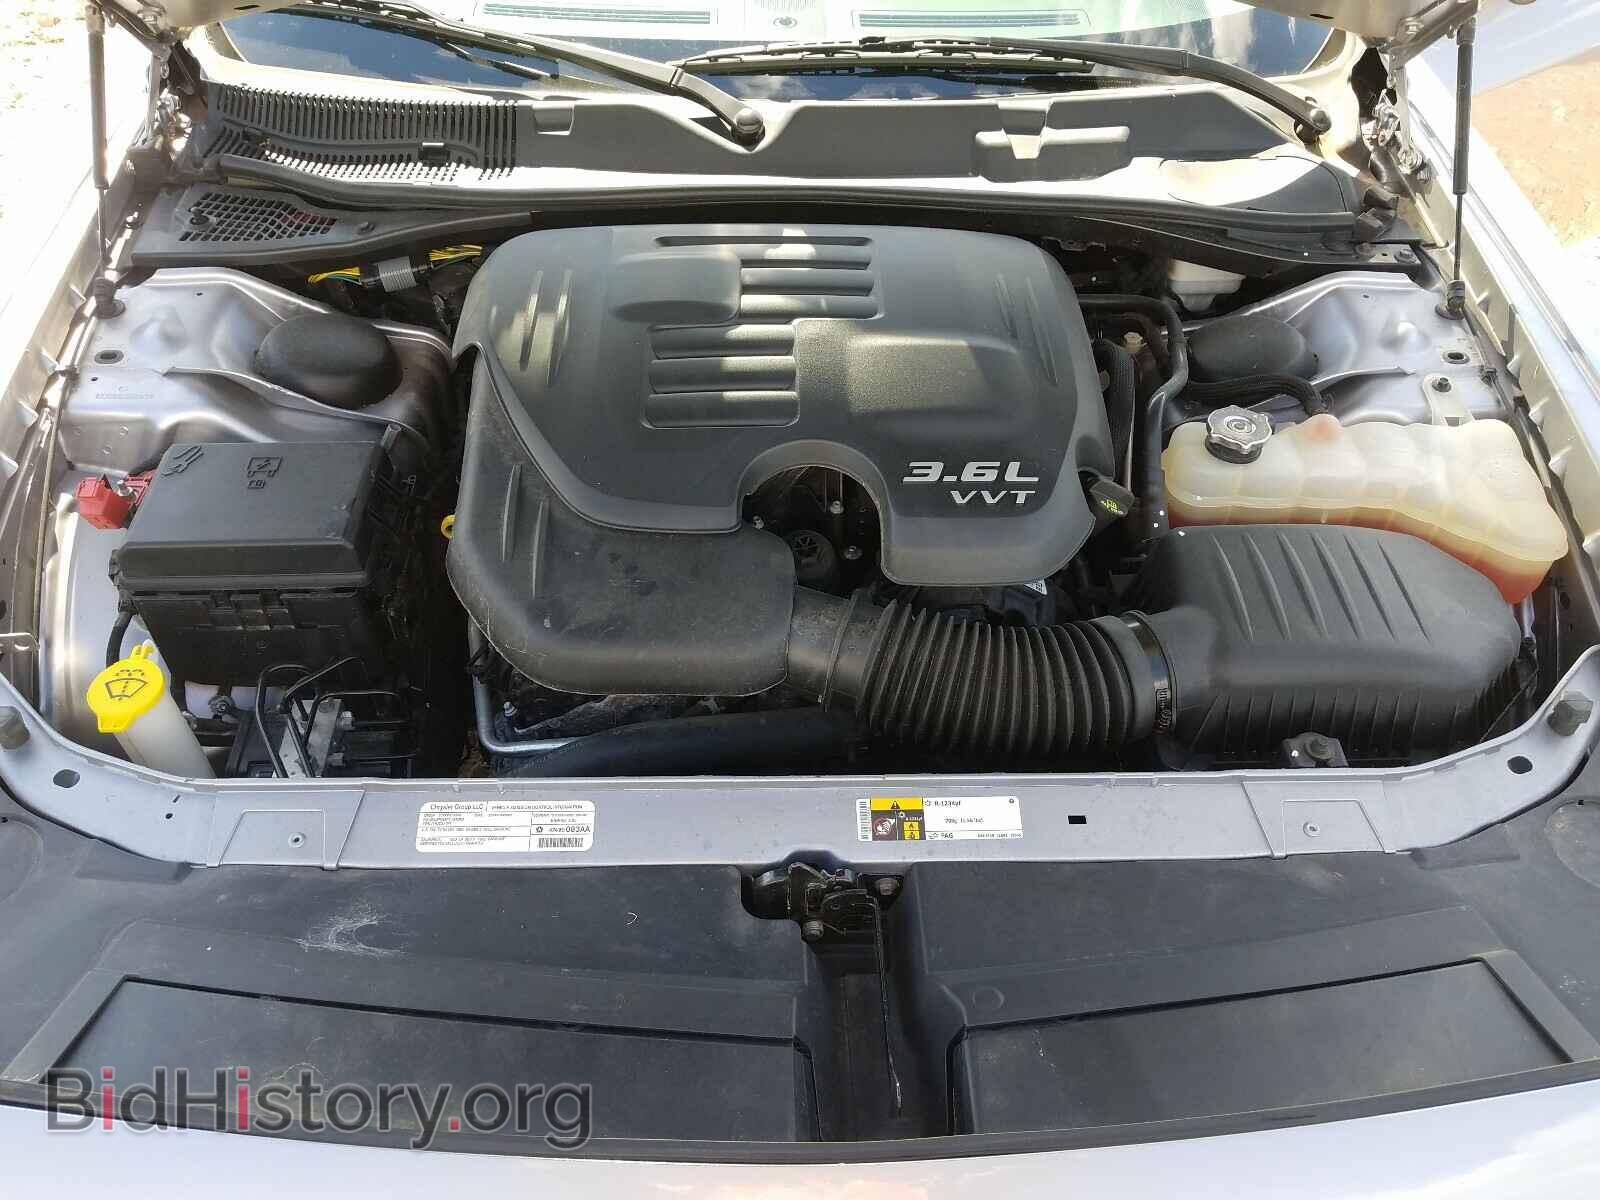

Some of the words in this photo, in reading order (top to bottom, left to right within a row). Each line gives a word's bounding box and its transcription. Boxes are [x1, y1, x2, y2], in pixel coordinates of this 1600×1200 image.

[903, 461, 1039, 482] 3.6L
[950, 490, 1036, 504] VVT
[454, 803, 472, 811] Group
